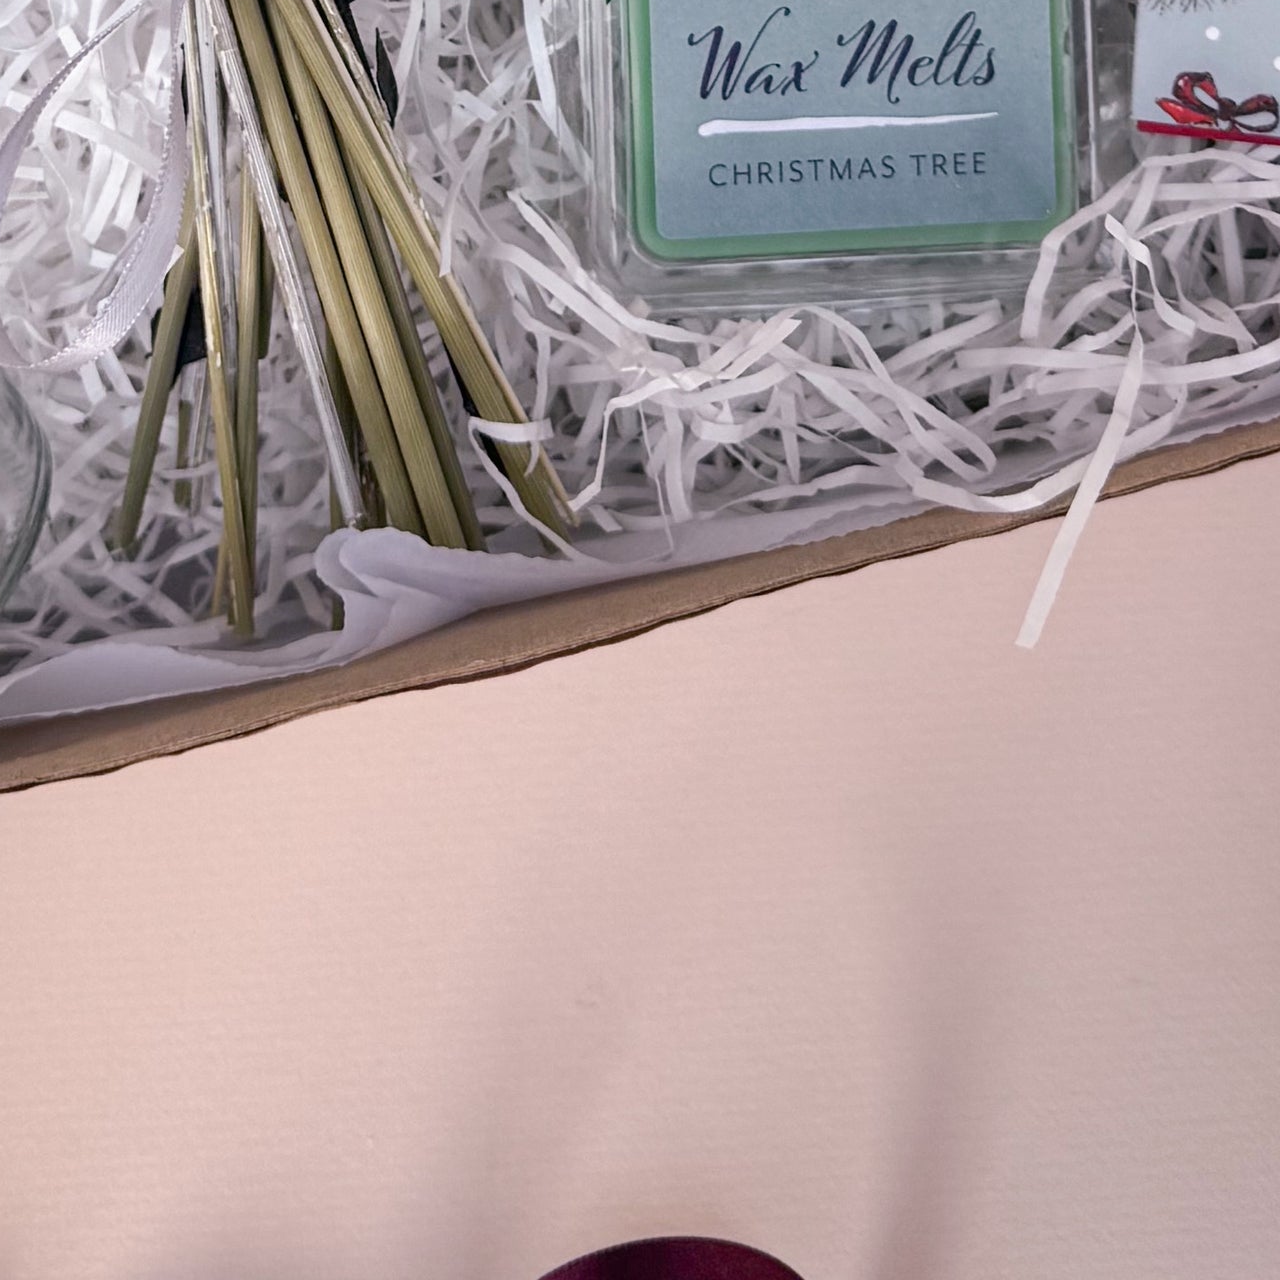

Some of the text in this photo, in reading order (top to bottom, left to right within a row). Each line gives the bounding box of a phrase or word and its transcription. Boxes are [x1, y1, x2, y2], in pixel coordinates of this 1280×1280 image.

[687, 6, 997, 104] Wax Melts
[707, 151, 987, 188] CHRISTMAS TREE
